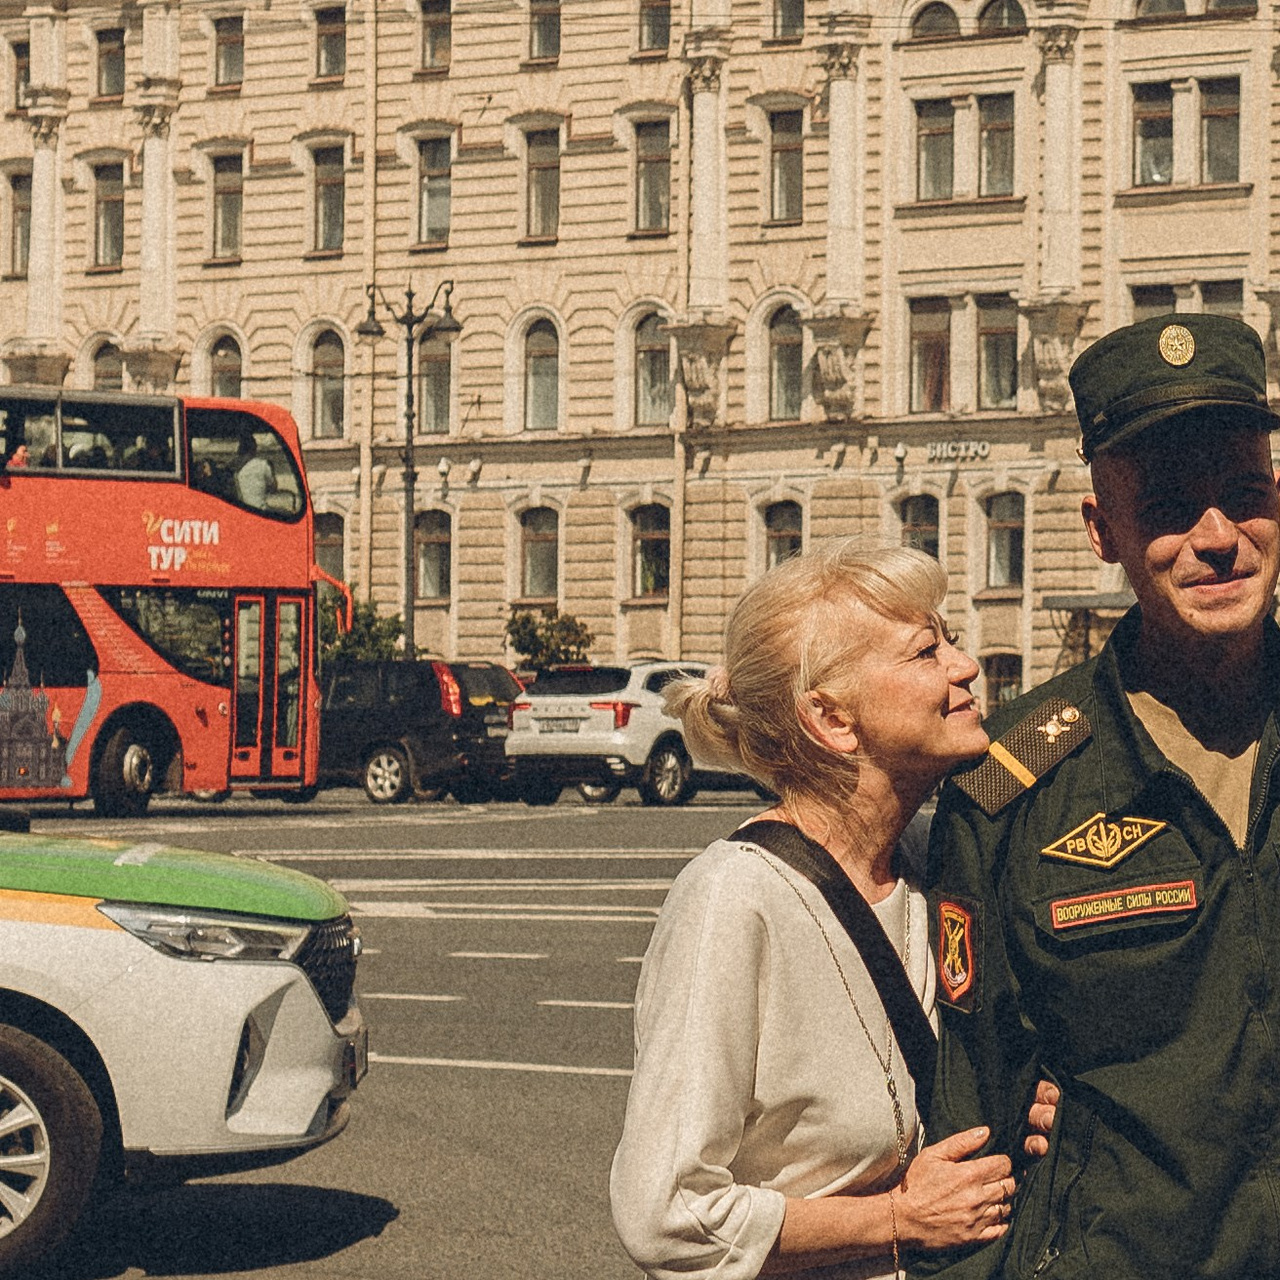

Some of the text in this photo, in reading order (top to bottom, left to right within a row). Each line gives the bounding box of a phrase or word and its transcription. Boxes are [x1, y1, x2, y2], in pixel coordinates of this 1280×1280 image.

[926, 440, 991, 459] БИСТРО
[160, 519, 220, 545] СИТИ
[147, 546, 188, 571] ТУР
[1066, 823, 1143, 854] РВ СН
[1056, 888, 1192, 922] ВООРУЖЕННЫЕ СИЛЫ РОССИИ
